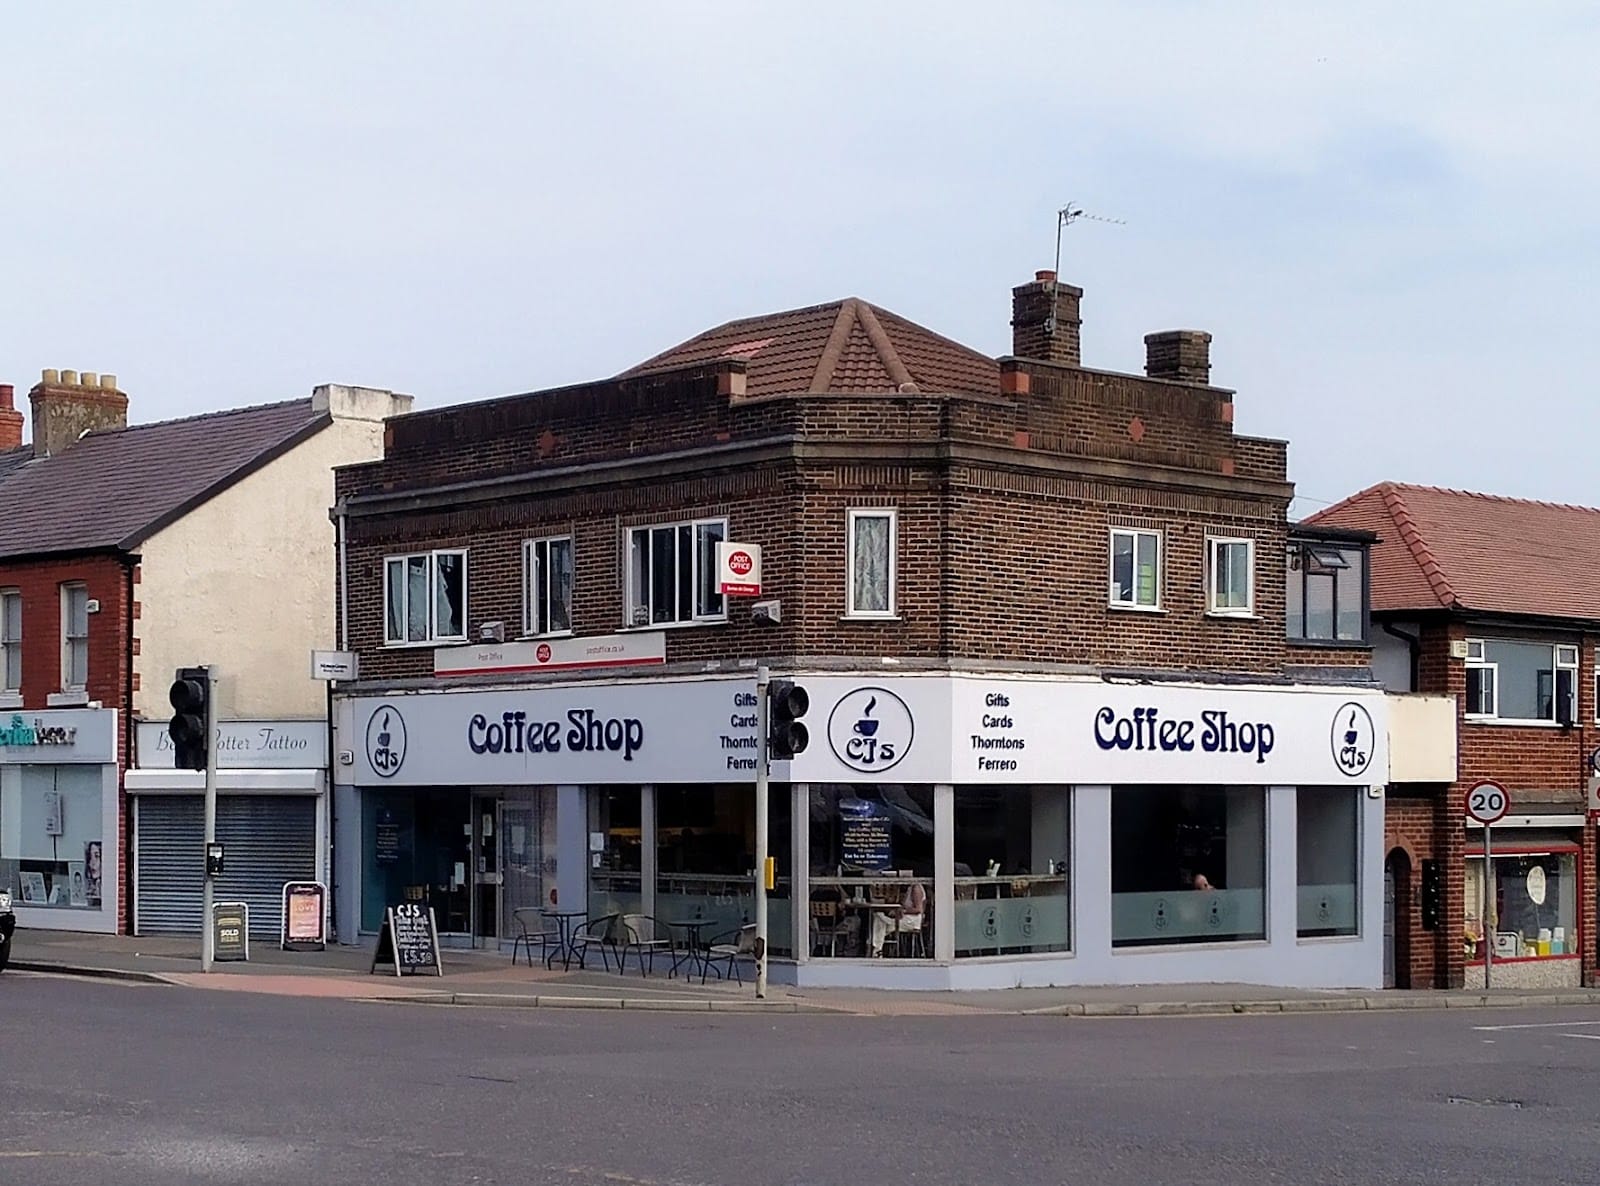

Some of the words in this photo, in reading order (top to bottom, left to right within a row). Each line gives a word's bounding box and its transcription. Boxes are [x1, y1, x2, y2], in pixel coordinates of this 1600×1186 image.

[730, 562, 751, 570] OFFICE
[478, 653, 489, 661] Post
[489, 652, 503, 661] Office
[734, 693, 758, 707] Gifts
[985, 693, 1010, 707] Gifts
[982, 714, 1013, 728] Cards
[256, 728, 308, 751] Tattoo
[468, 711, 561, 755] Coffee
[566, 709, 644, 761] Shop
[1094, 706, 1195, 751] Coffee
[1201, 710, 1275, 763] Shop
[971, 735, 1025, 750] Thorntons
[846, 738, 895, 764] CJs
[1340, 747, 1366, 768] CJs
[374, 748, 399, 770] CJs
[978, 756, 1017, 770] Ferrero
[1472, 793, 1503, 811] 20
[220, 928, 240, 937] SOLD
